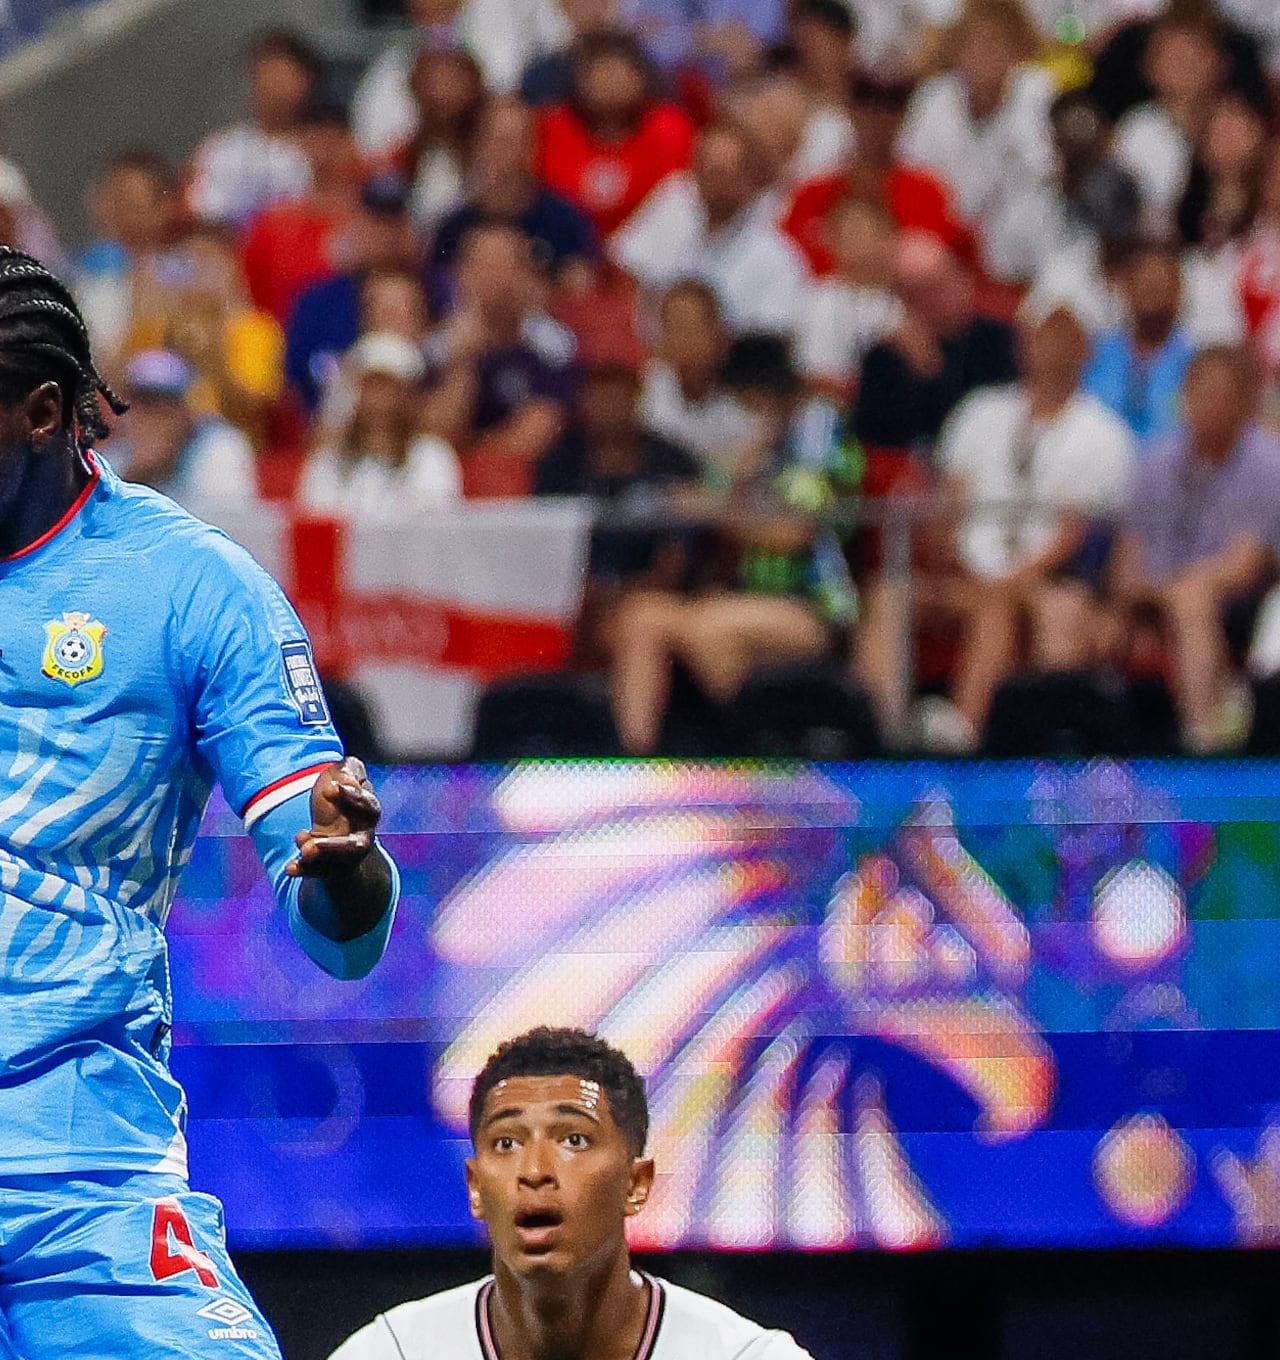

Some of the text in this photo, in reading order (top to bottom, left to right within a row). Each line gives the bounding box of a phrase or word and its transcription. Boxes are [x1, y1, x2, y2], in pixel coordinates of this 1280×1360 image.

[51, 663, 94, 679] FECOFA
[150, 1199, 222, 1288] 4
[207, 1328, 257, 1340] umbro
